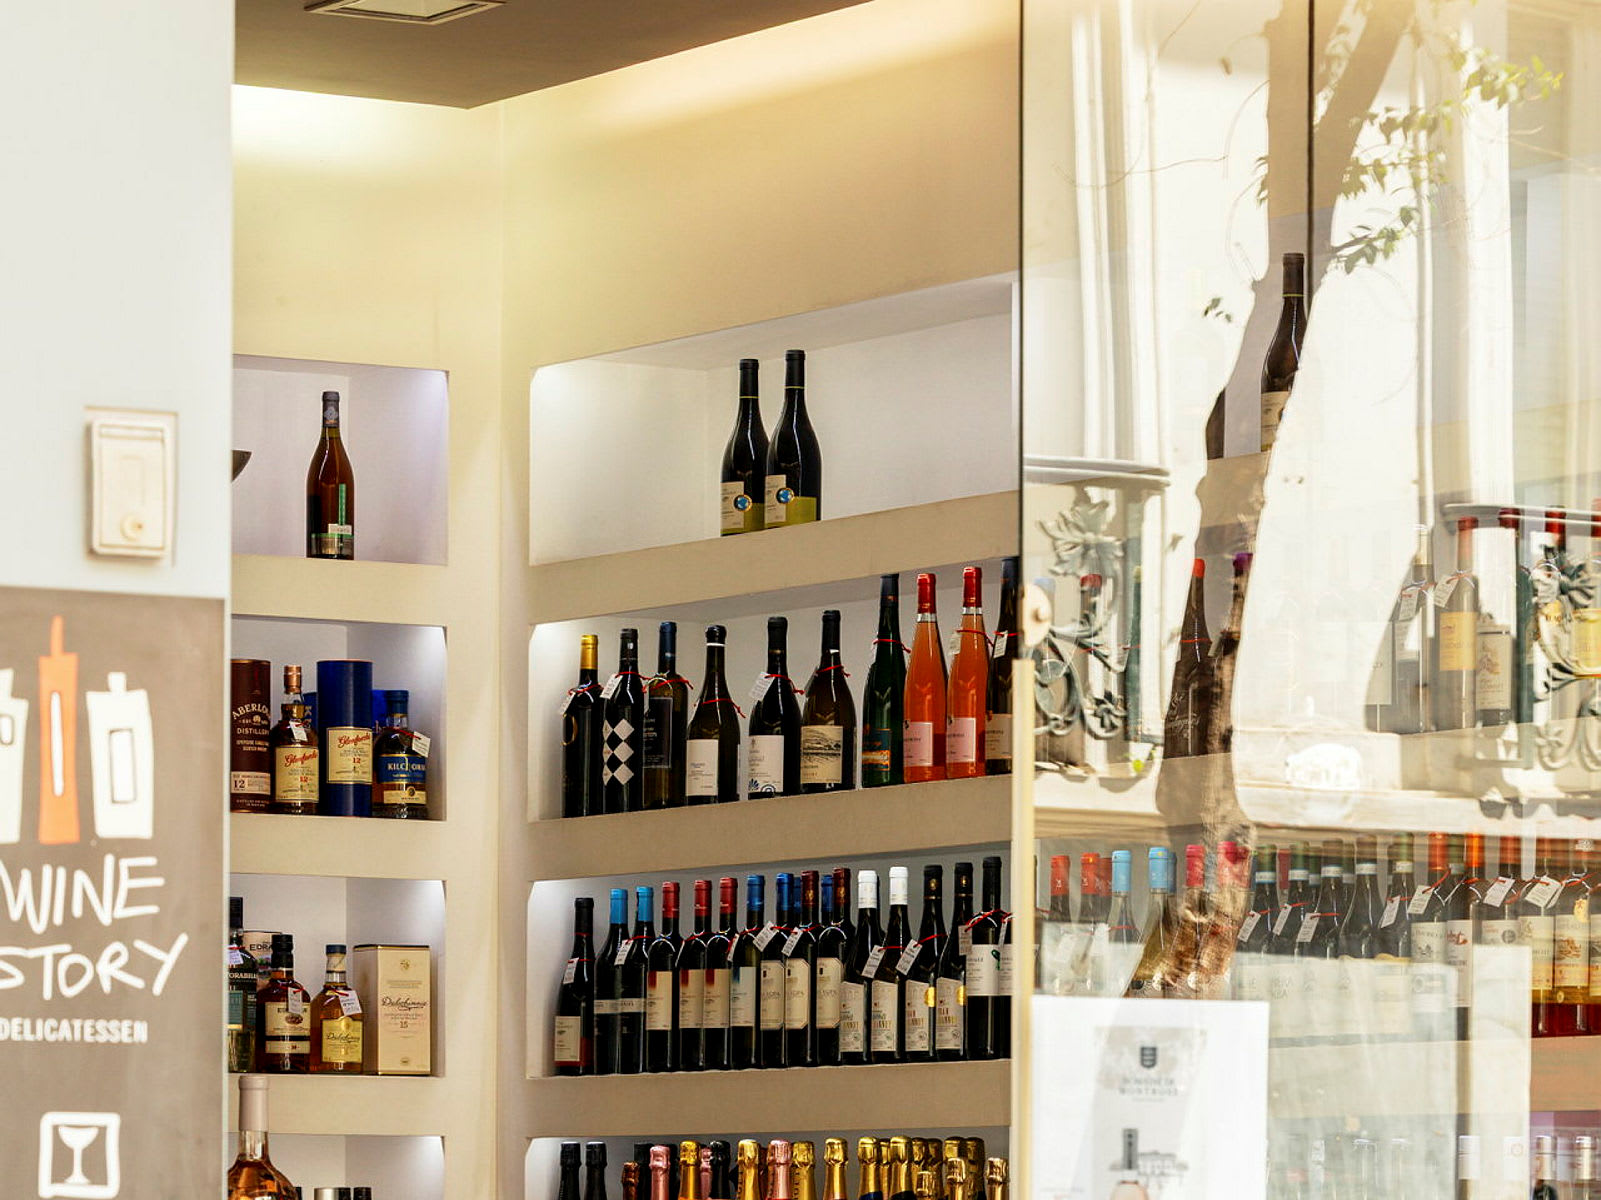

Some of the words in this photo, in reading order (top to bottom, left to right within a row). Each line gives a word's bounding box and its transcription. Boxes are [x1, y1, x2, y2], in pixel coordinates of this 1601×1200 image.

[234, 779, 246, 789] 12
[0, 853, 165, 935] WINE
[0, 932, 189, 1001] STORY
[0, 1016, 149, 1043] DELICATESSEN
